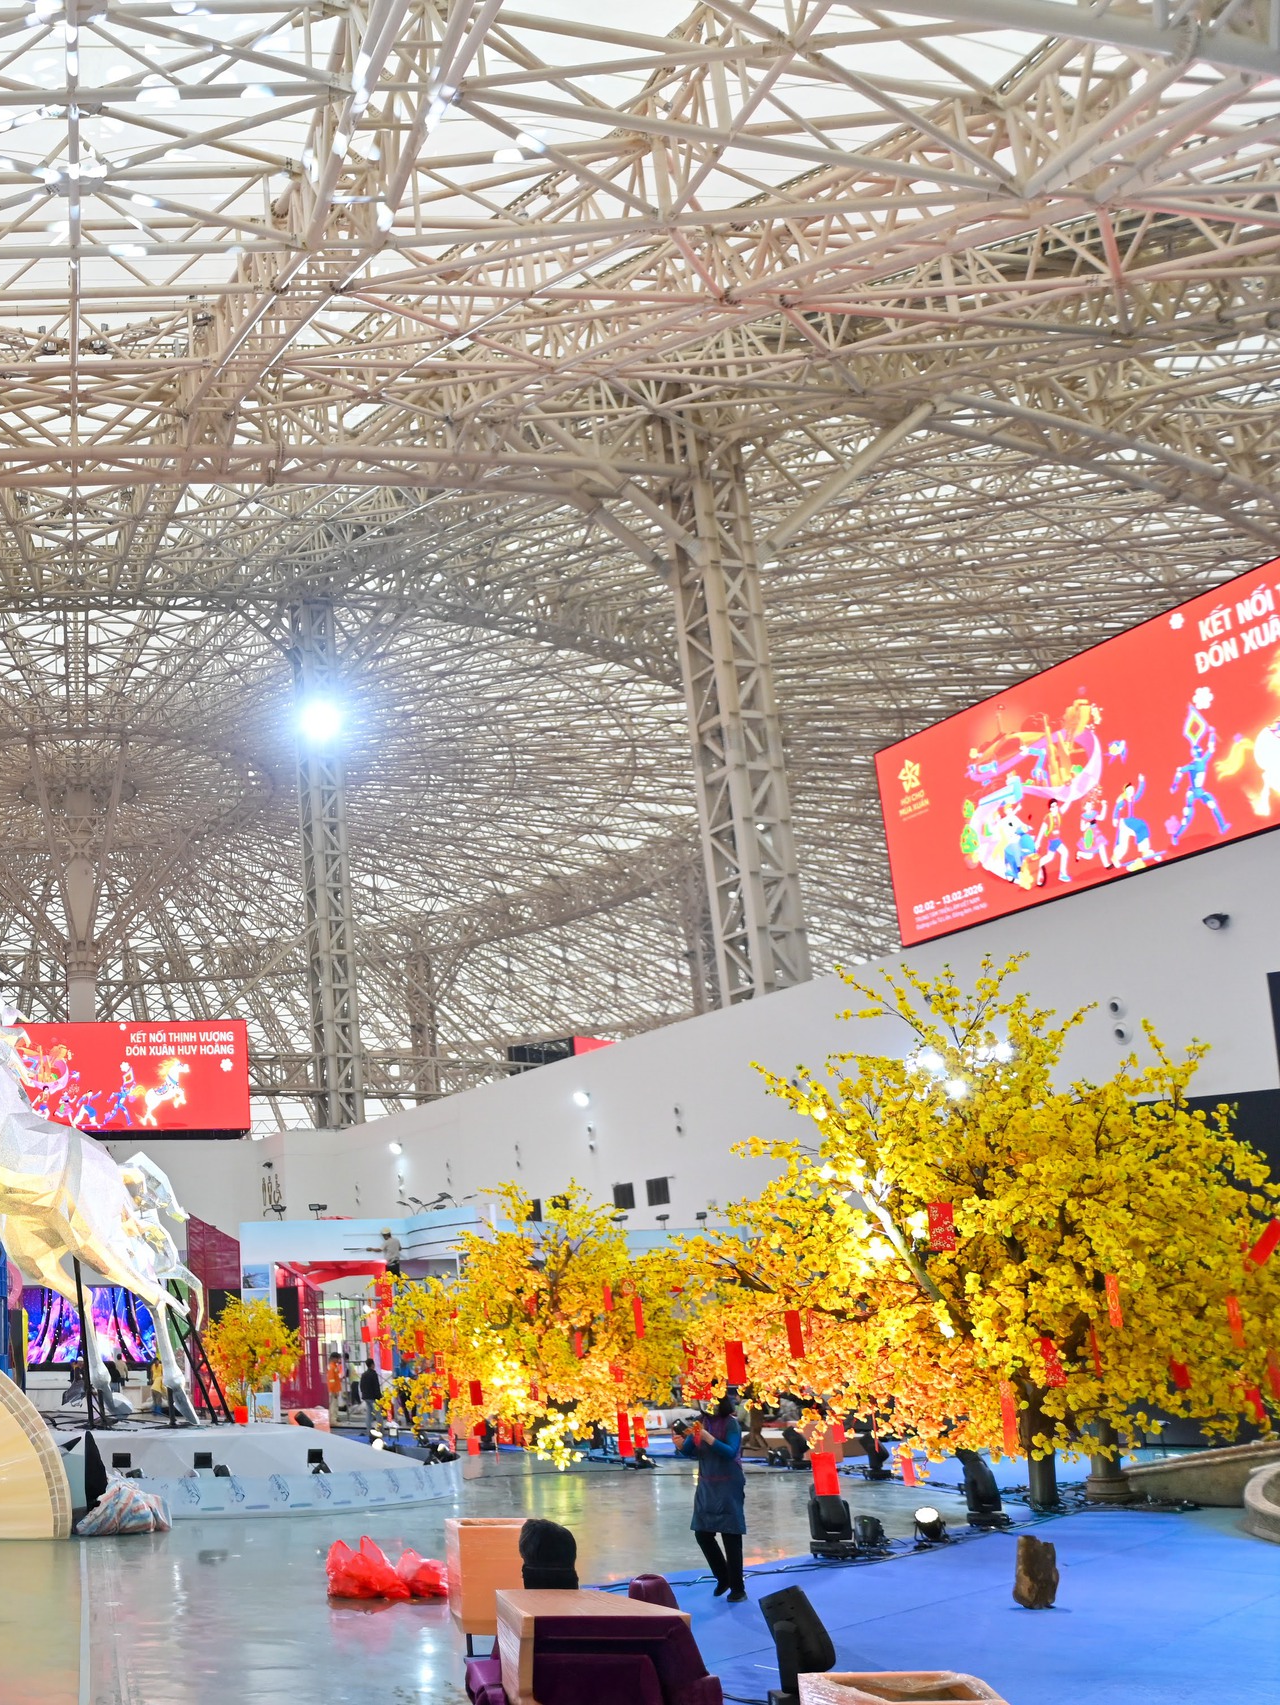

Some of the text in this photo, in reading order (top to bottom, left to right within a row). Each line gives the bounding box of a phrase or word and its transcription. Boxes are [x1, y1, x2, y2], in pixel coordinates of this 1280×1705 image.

[1198, 583, 1275, 641] KẾT NỐI
[1194, 614, 1280, 674] ĐÓN XUÂ
[913, 900, 935, 914] 02.02
[942, 883, 984, 905] 13.02.2026
[125, 1042, 235, 1056] ĐÓN XUÂN HUY HOÀNG
[130, 1029, 234, 1043] KẾT NỐI THỊNH VƯỢNG
